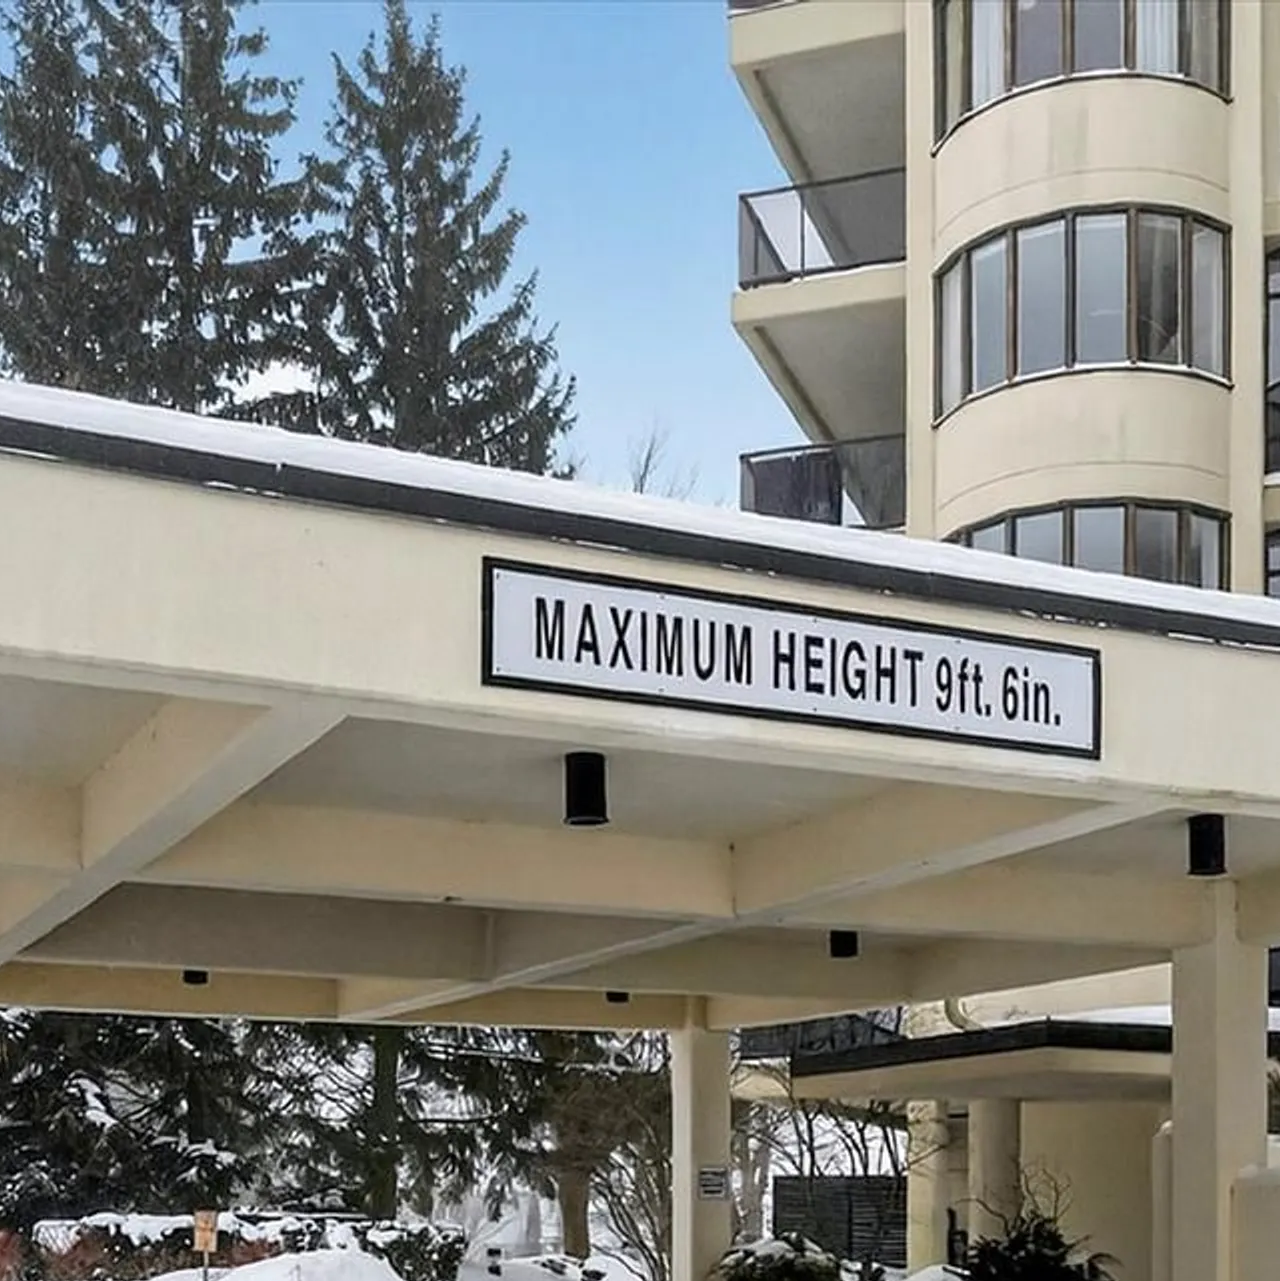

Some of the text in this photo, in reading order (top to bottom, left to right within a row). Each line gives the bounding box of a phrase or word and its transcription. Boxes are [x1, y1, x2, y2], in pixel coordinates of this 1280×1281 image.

[535, 597, 1061, 727] MAXIMUM HEIGHT 9ft. 6in.
